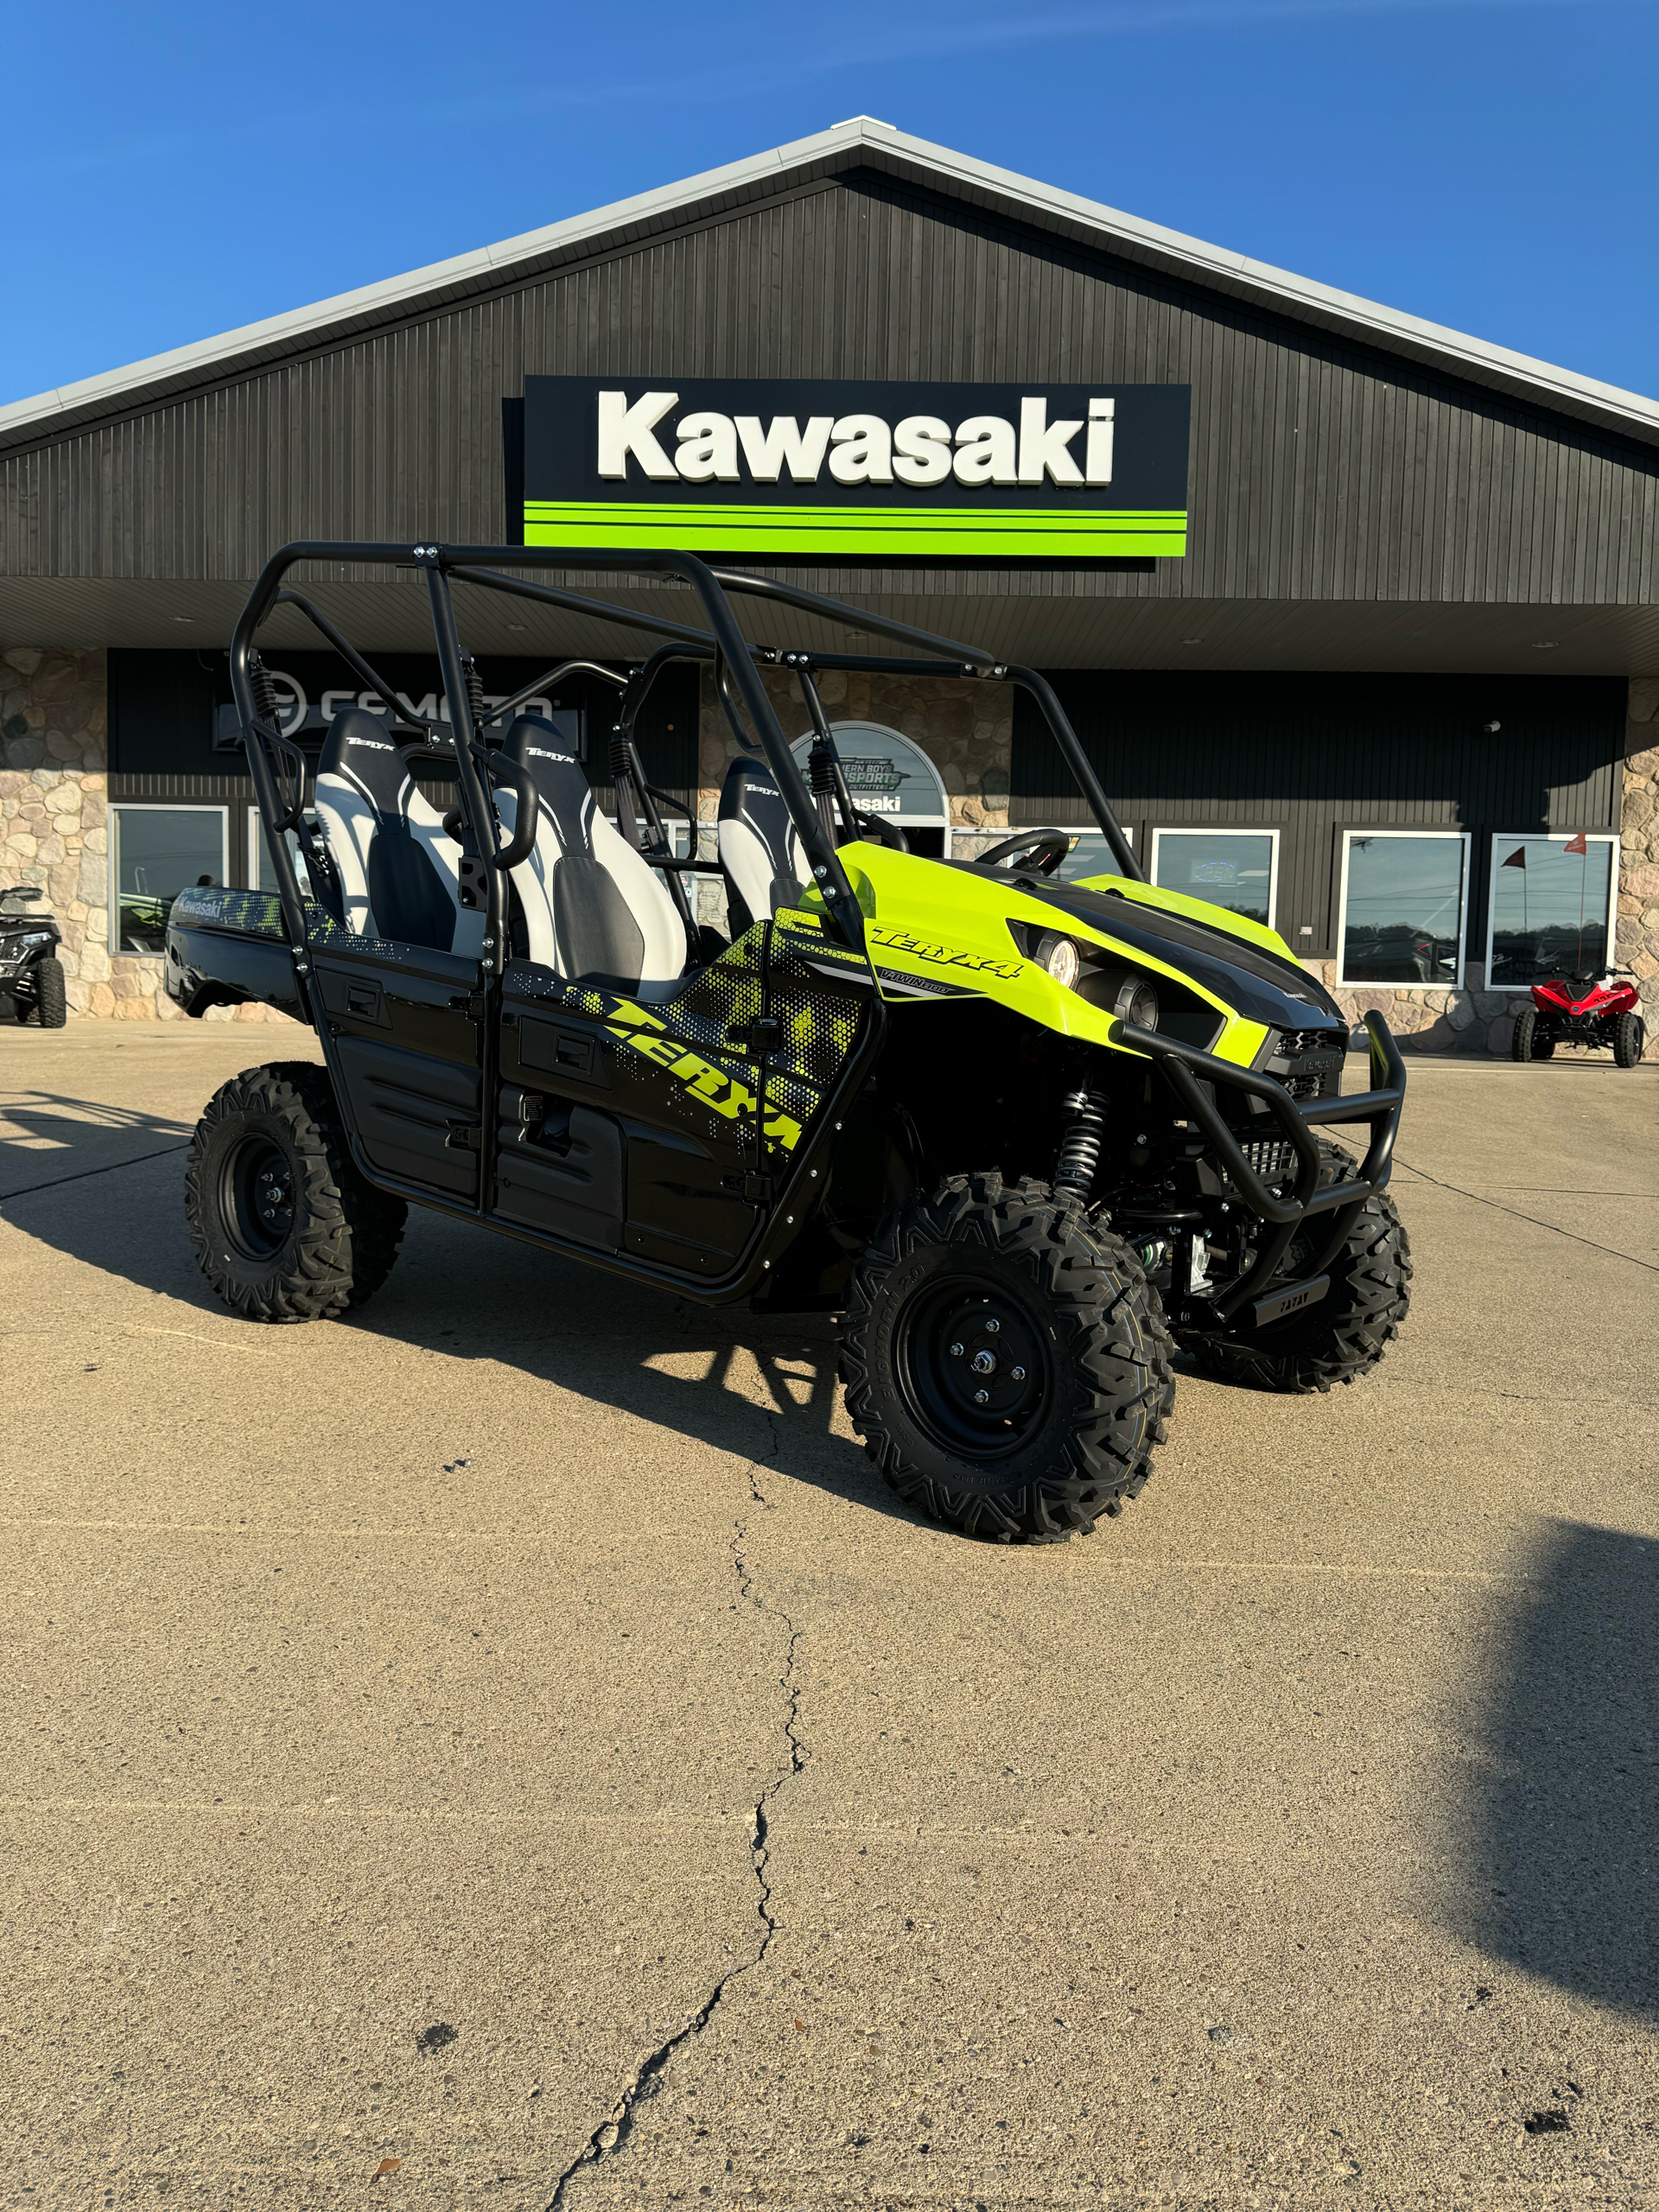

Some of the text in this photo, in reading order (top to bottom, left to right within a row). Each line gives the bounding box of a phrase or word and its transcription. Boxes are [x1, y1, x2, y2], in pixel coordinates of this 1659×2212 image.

[598, 391, 1115, 486] Kawasaki
[867, 765, 893, 773] BOYS
[1193, 867, 1234, 880] OPEN
[178, 897, 222, 918] Kawasaki
[874, 1263, 925, 1402] BIGHORN 2.0
